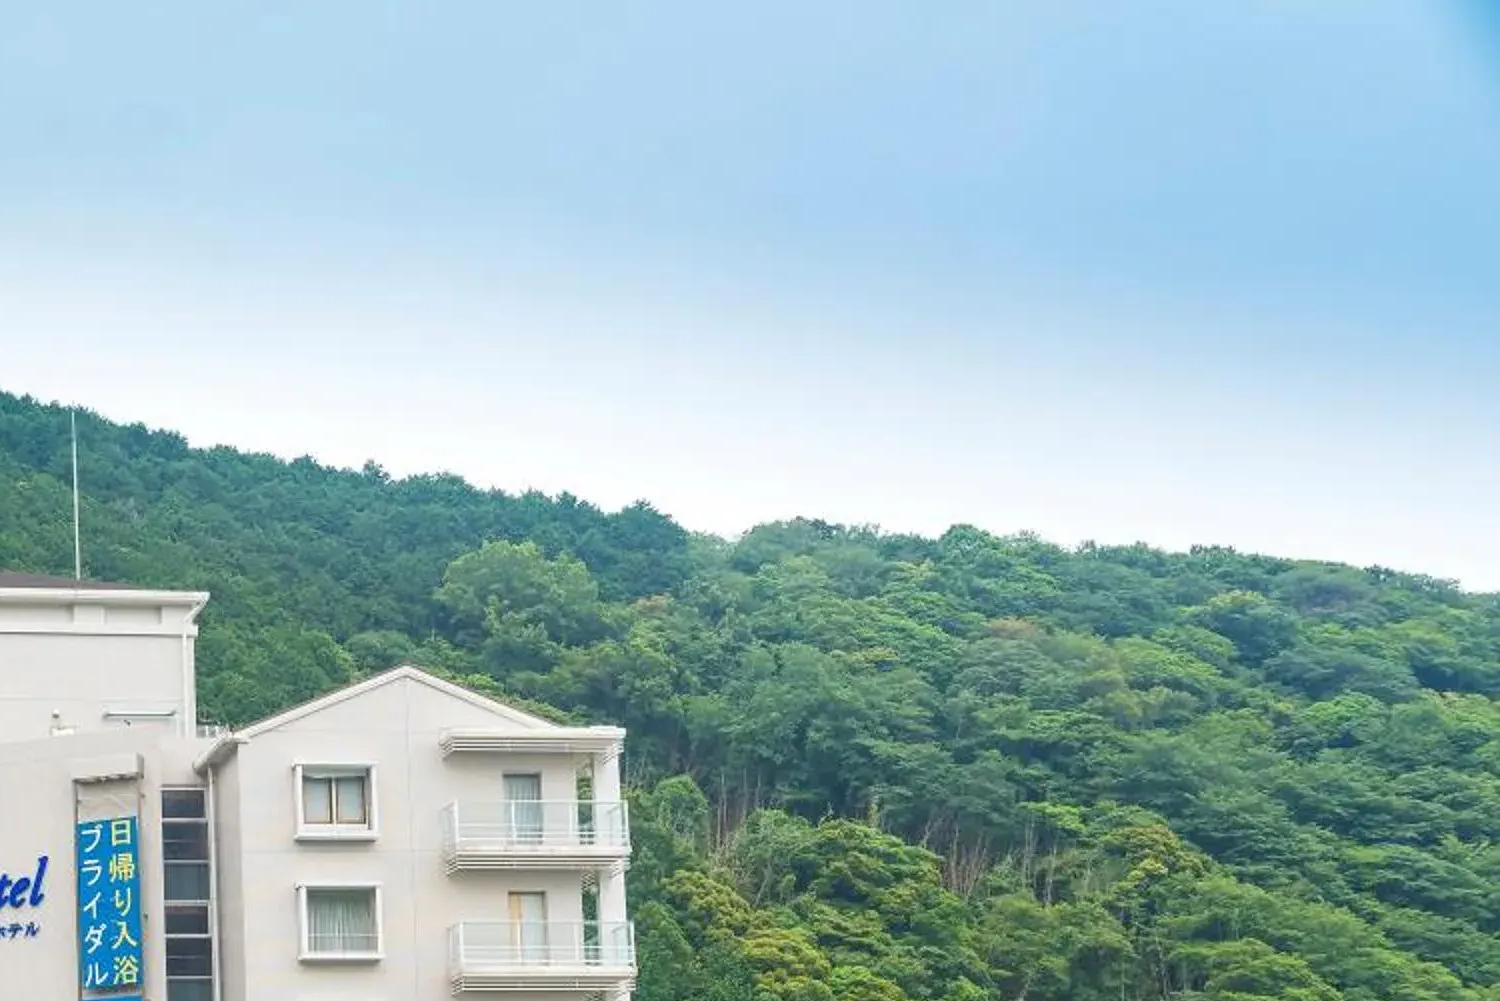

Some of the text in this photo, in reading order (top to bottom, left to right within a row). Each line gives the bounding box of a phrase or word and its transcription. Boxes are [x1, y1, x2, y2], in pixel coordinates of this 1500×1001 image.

[80, 824, 108, 988] ブライダル
[108, 820, 139, 985] 日帰り入浴
